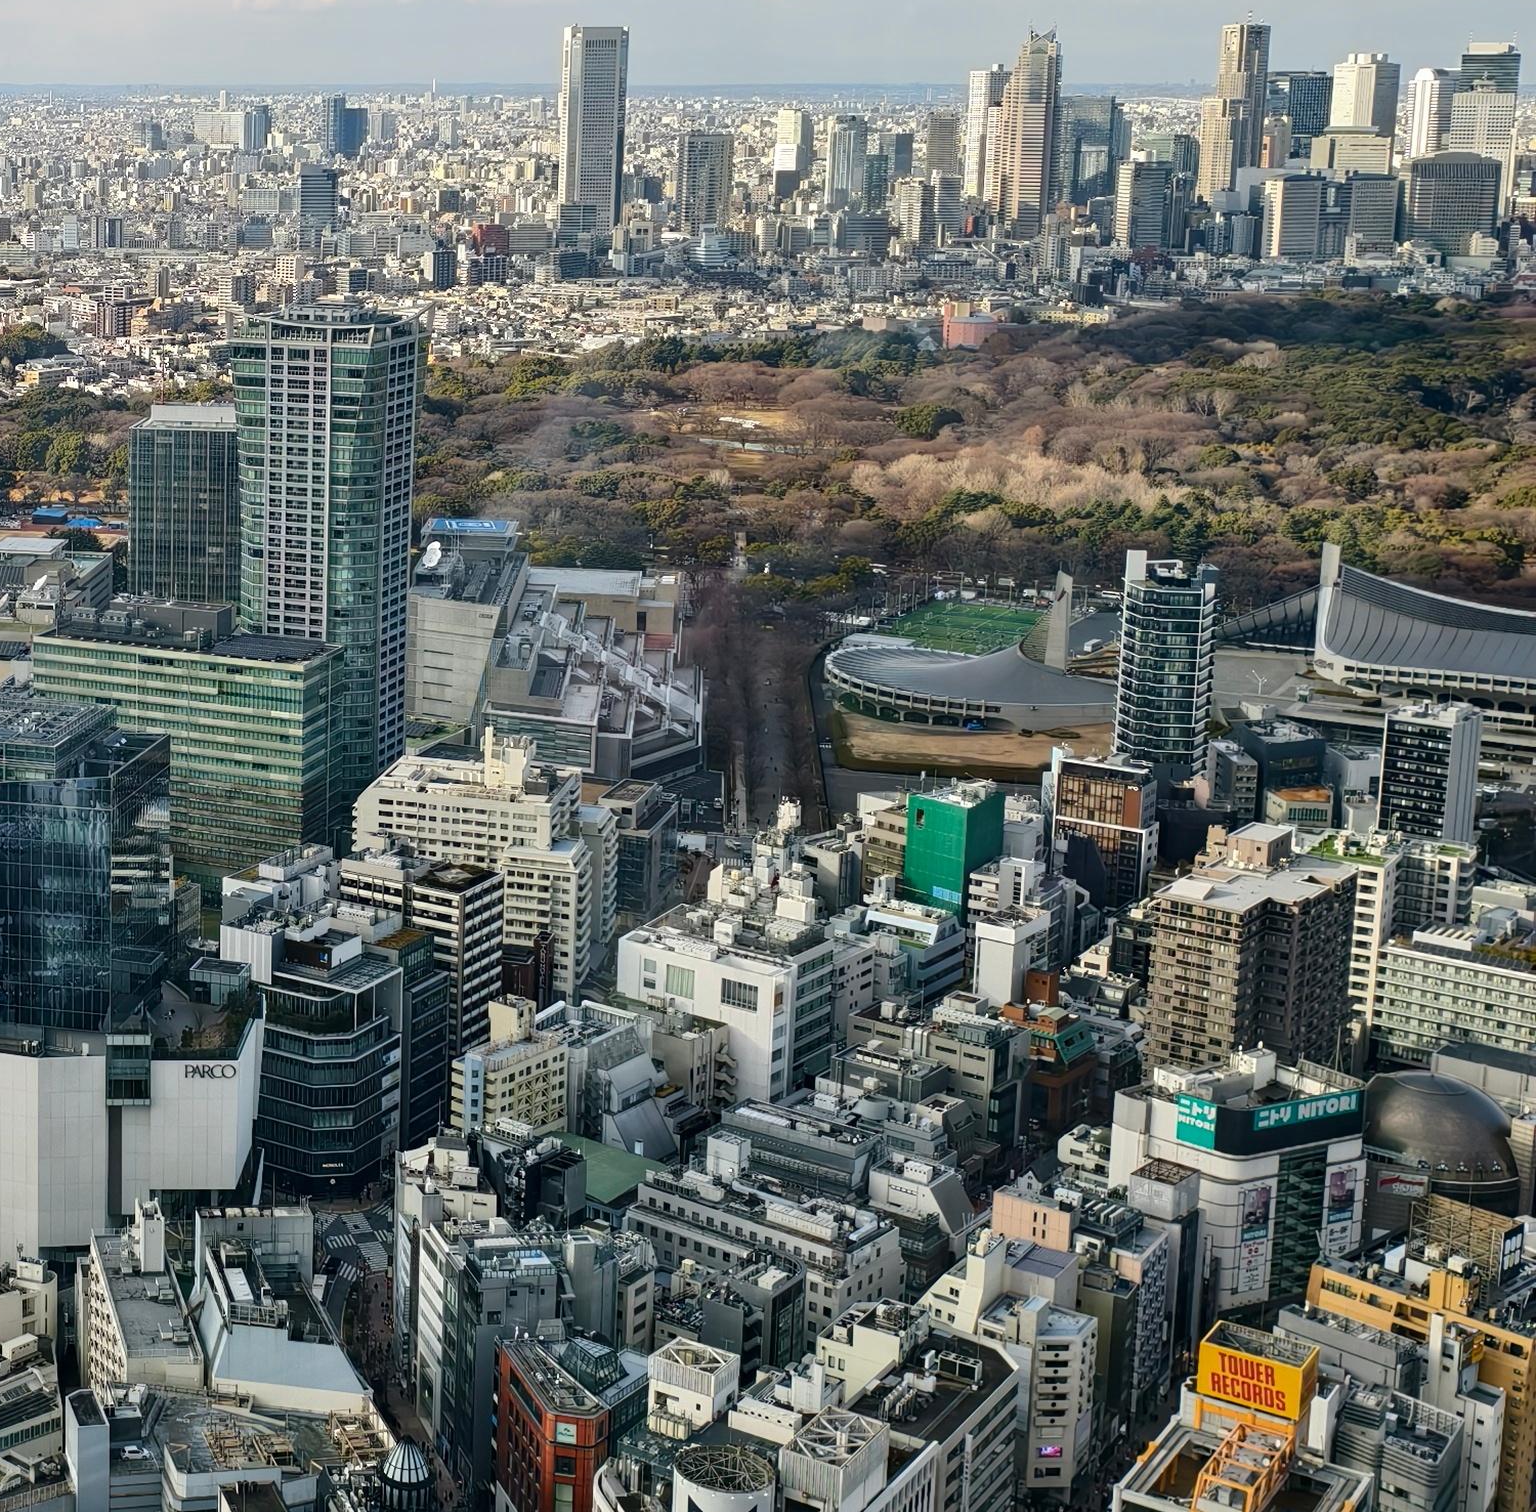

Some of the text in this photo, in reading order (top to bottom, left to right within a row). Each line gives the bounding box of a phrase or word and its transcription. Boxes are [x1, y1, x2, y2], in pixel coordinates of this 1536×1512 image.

[184, 1064, 236, 1078] PARCO
[1178, 1114, 1214, 1131] NITORI
[1179, 1098, 1216, 1120] ニトリ
[1258, 1094, 1357, 1128] ニトリ NITORI
[1218, 1352, 1275, 1386] TOWER
[1211, 1372, 1286, 1411] RECORDS
